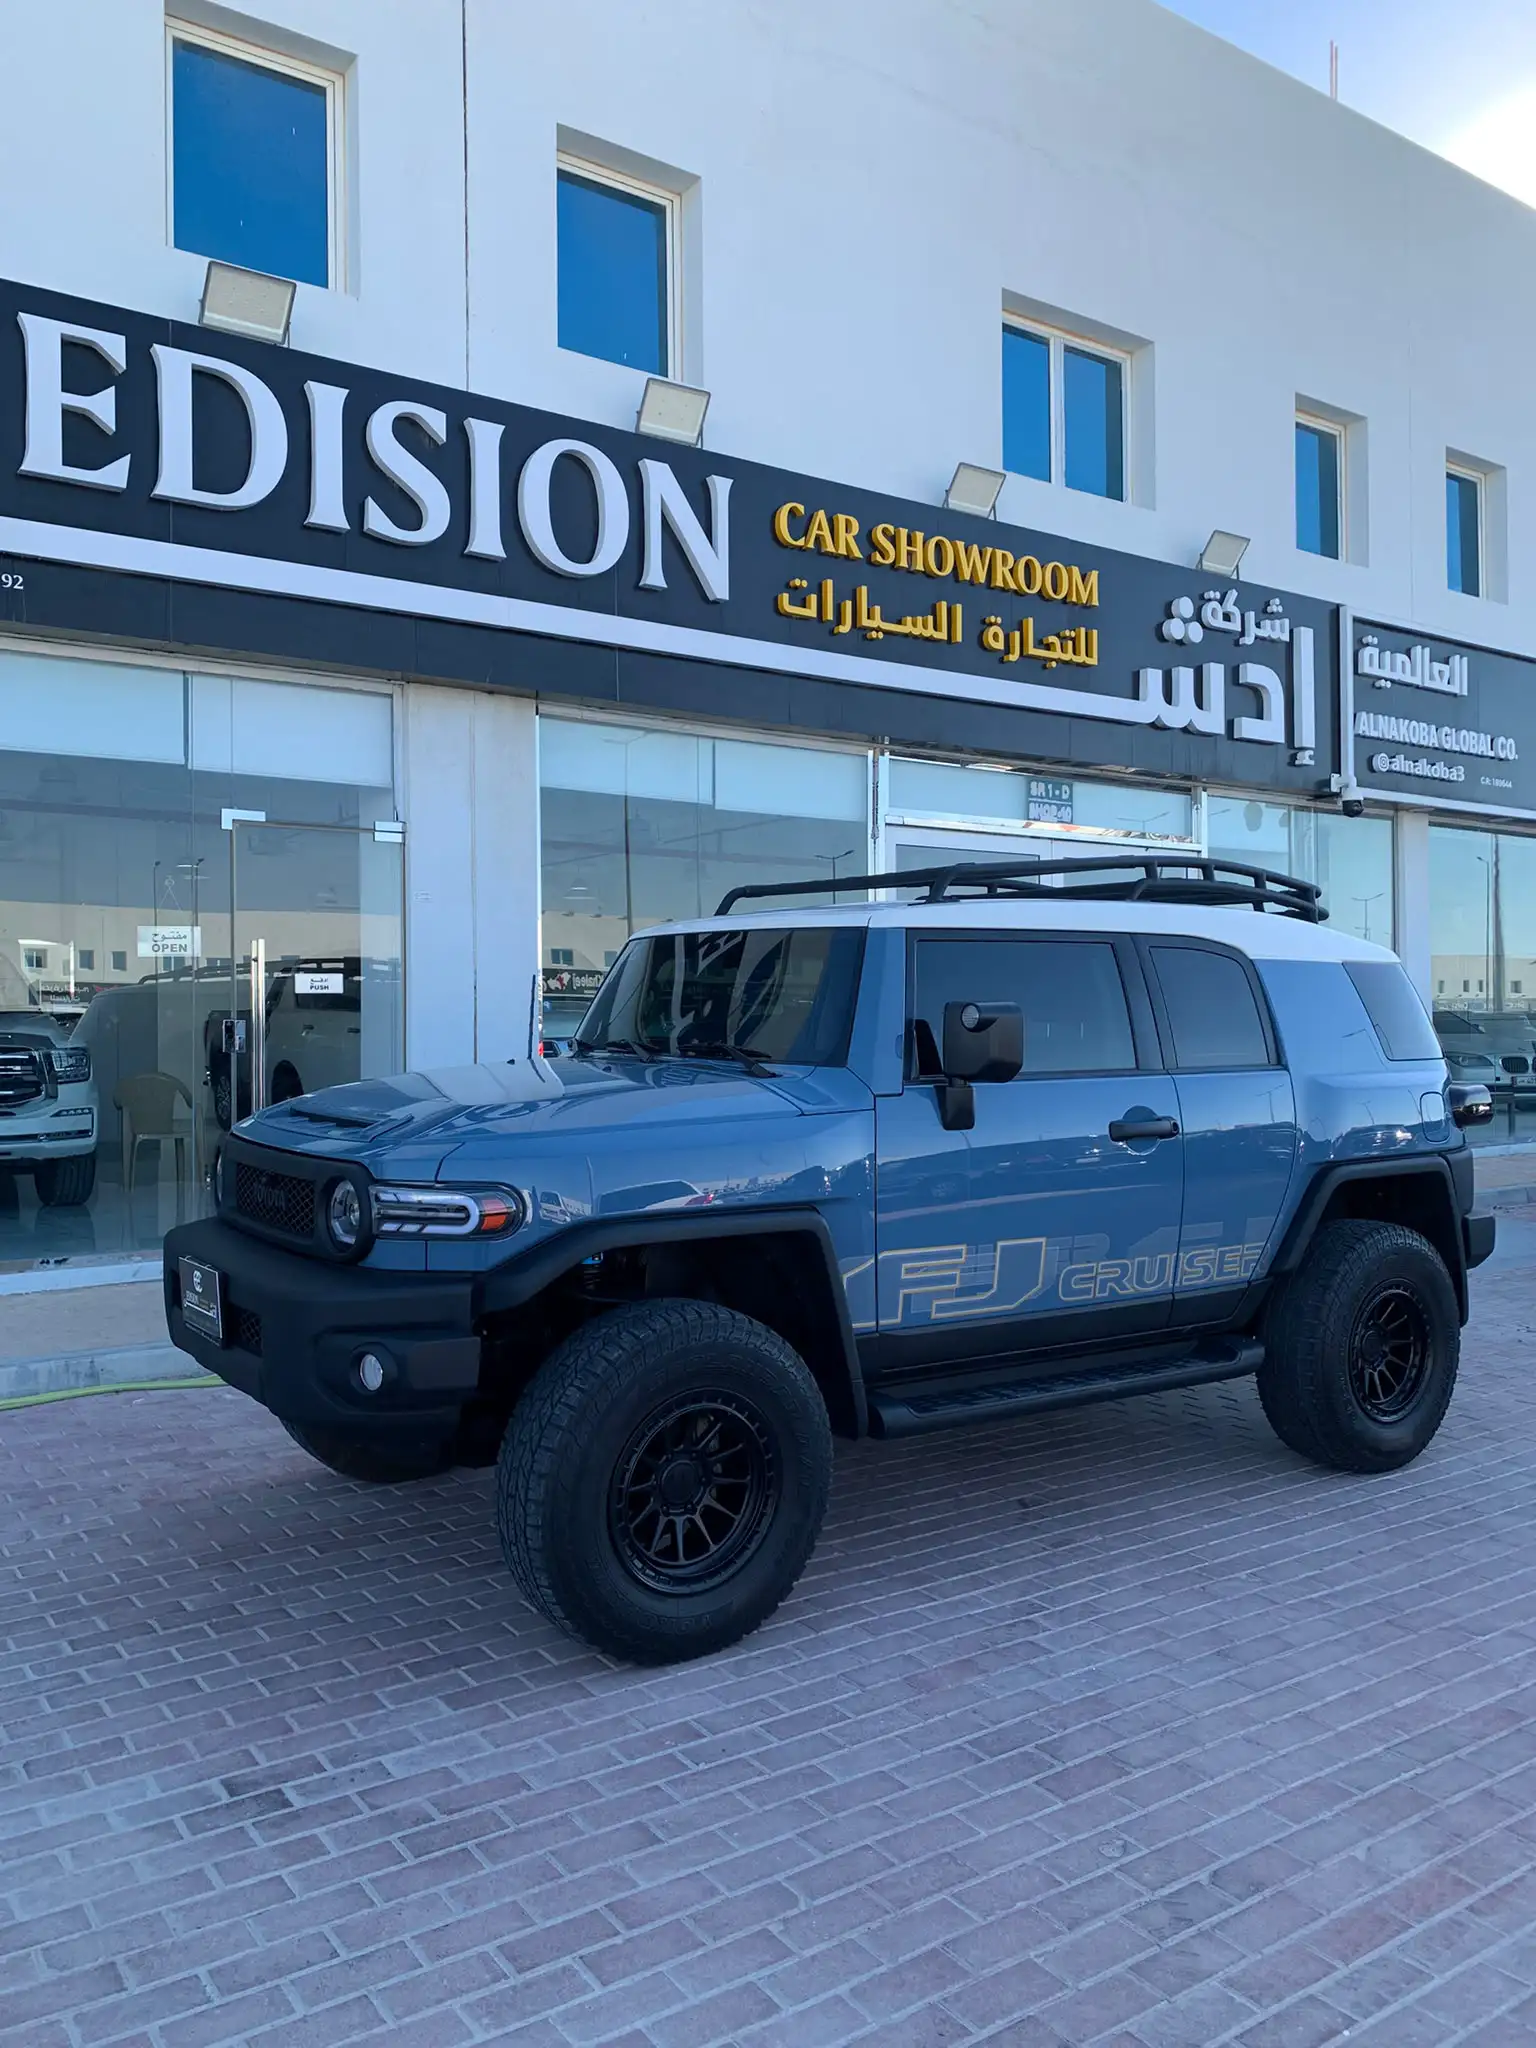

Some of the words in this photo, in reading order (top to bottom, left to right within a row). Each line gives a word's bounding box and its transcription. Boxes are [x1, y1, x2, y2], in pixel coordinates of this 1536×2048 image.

[17, 311, 734, 602] EDISION
[774, 502, 863, 559] CAR
[871, 523, 1099, 606] SHOWROOM
[777, 577, 963, 644] السيارات
[1201, 588, 1290, 645] شركة
[982, 615, 1098, 670] للتجارة
[1358, 635, 1468, 696] العالمية
[1355, 711, 1439, 748] ALNAKOBA
[1437, 726, 1494, 757] GLOBAL
[1493, 736, 1518, 760] CO.
[151, 943, 188, 953] OPEN
[843, 1236, 1047, 1328] FJ
[1058, 1241, 1271, 1301] CRUISER
